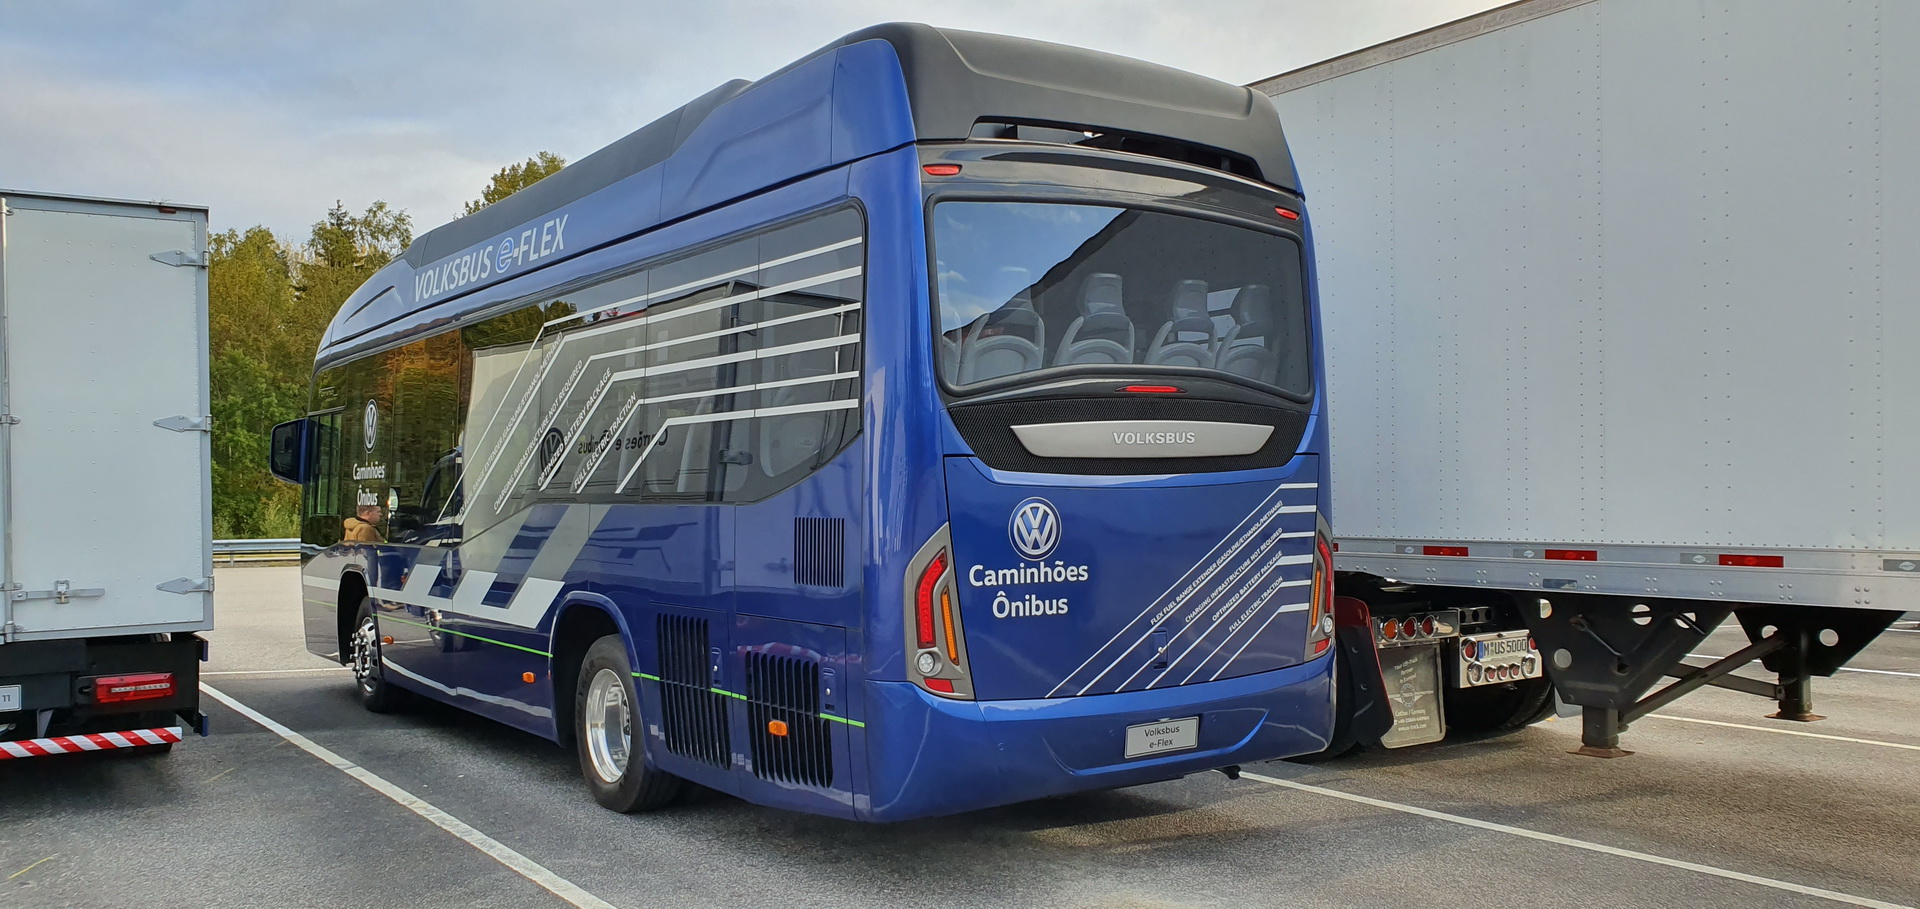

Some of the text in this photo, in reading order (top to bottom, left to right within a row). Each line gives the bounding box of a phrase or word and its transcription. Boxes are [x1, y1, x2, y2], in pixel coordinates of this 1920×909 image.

[415, 214, 569, 302] VOLKSBUS e-FLEX
[493, 359, 583, 511] CHARGING INFRASTRUCTURE NOT REQUIRED
[536, 366, 612, 487] OPTIMIZED BATTERY PACKAGE
[573, 391, 637, 490] FULL ELECTRIC TRACTION
[1113, 432, 1196, 445] VOLKSBUS
[352, 461, 385, 480] Caminhões
[357, 484, 378, 506] Ônibus
[968, 560, 1089, 587] Caminhões
[1149, 610, 1164, 625] FLEX
[1162, 599, 1176, 614] FUEL
[1175, 584, 1193, 603] RANGE
[1191, 561, 1218, 588] EXTENDER
[1184, 526, 1283, 623] CHARGING INFRASTRUCTURE NOT REQUIRED
[1211, 549, 1283, 622] OPTIMIZED BATTERY PACKAGE
[992, 590, 1069, 618] Ônibus
[1228, 575, 1283, 633] FULL ELECTRIC TRACTION
[1506, 639, 1527, 653] 5000
[1144, 726, 1180, 737] Volksbus
[1149, 738, 1174, 749] e-Flex
